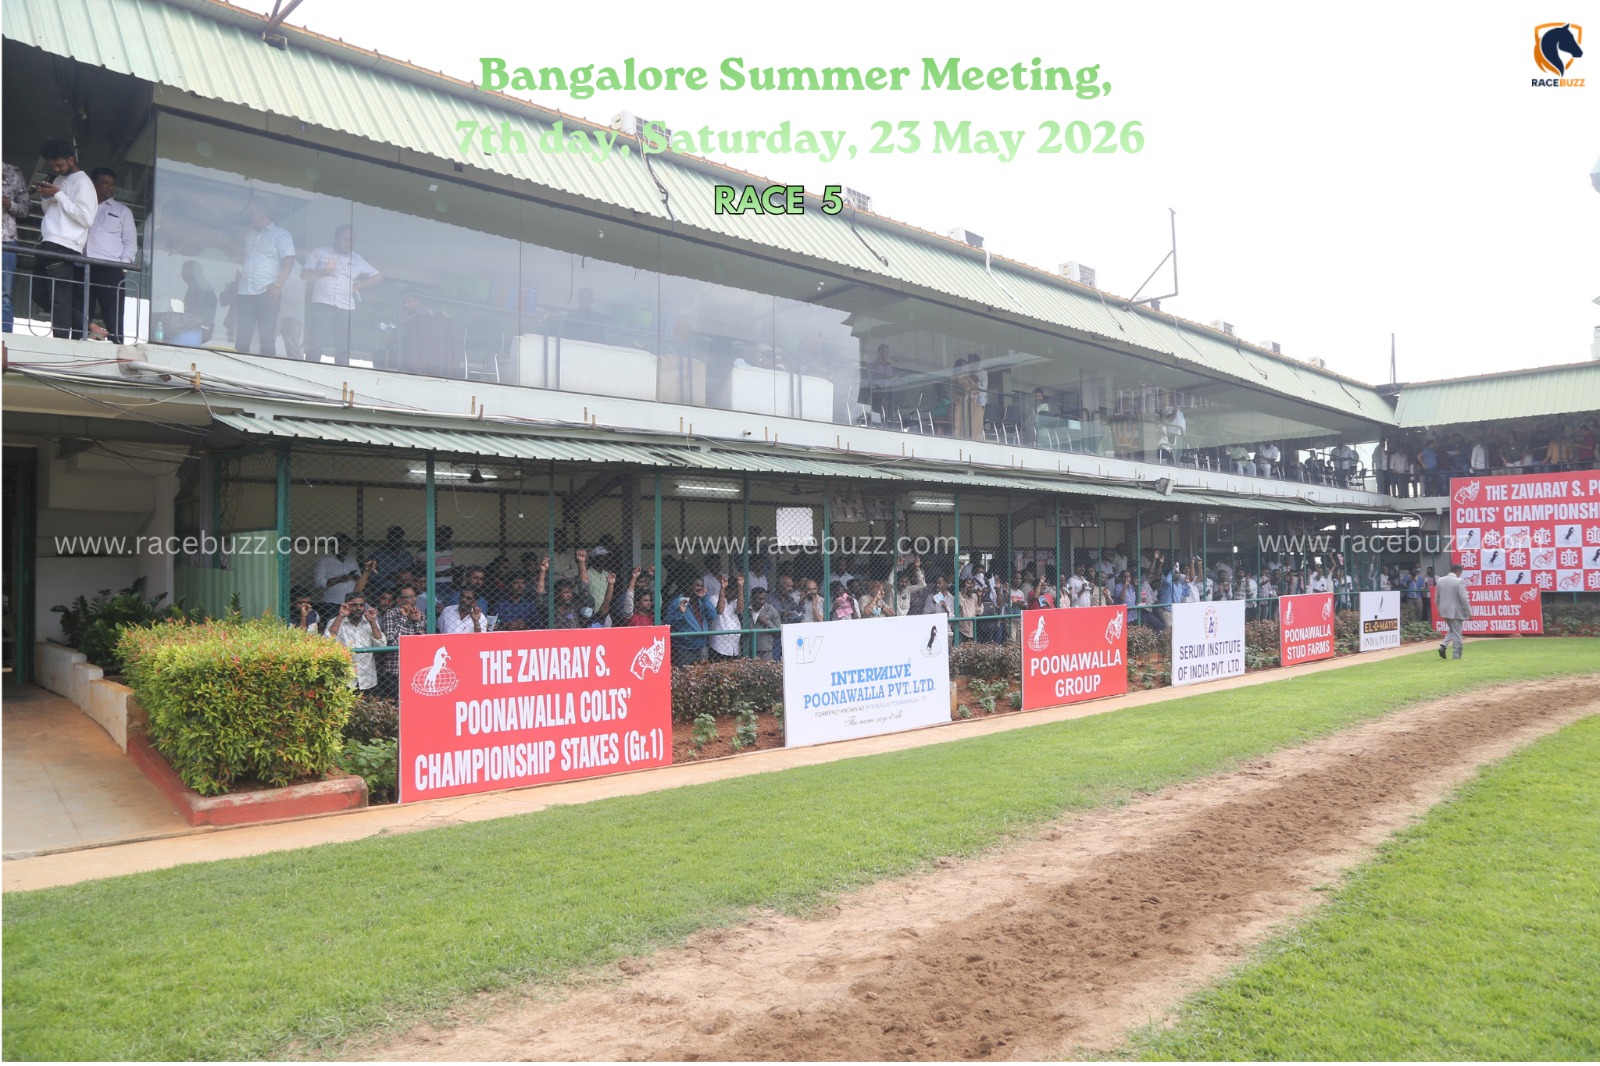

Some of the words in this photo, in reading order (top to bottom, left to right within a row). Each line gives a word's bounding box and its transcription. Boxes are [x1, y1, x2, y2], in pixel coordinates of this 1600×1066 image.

[1485, 485, 1508, 501] THE
[1511, 481, 1569, 499] ZAVARAY
[1571, 480, 1585, 497] S.
[1456, 506, 1500, 524] COLTS'
[1471, 590, 1502, 602] ZAVARAY
[1504, 589, 1511, 601] S.
[1497, 604, 1522, 616] COLTS'
[1284, 623, 1332, 644] POONAWALLA
[1436, 620, 1488, 632] CHAONSHIP
[1490, 620, 1516, 632] STAKES
[1518, 619, 1538, 632] (Gr.1)
[1179, 642, 1206, 661] SERUM
[1207, 639, 1242, 656] INSTITUTE
[1287, 644, 1306, 660] STUD
[1307, 640, 1330, 656] FARMS
[479, 649, 513, 685] THE
[517, 645, 592, 683] ZAVARAY
[595, 644, 611, 677] S.
[1030, 648, 1123, 677] POONAWALLA
[1177, 666, 1189, 681] OF
[1189, 661, 1210, 680] INDIA
[1211, 661, 1226, 677] PVT.
[1227, 658, 1242, 674] LTD.
[830, 663, 912, 686] INTERVALVE
[803, 685, 886, 709] POONAWALLA
[887, 681, 912, 698] PVT.
[913, 678, 936, 693] LTD.
[1055, 674, 1102, 698] GROUP
[455, 692, 576, 736] POONAWALLA
[580, 687, 632, 723] COLTS'
[815, 708, 841, 718] FORMERLY
[414, 740, 556, 791] CHAMPIONSHIP
[560, 732, 619, 771] STAKES
[623, 727, 664, 765] (Gr.1)
